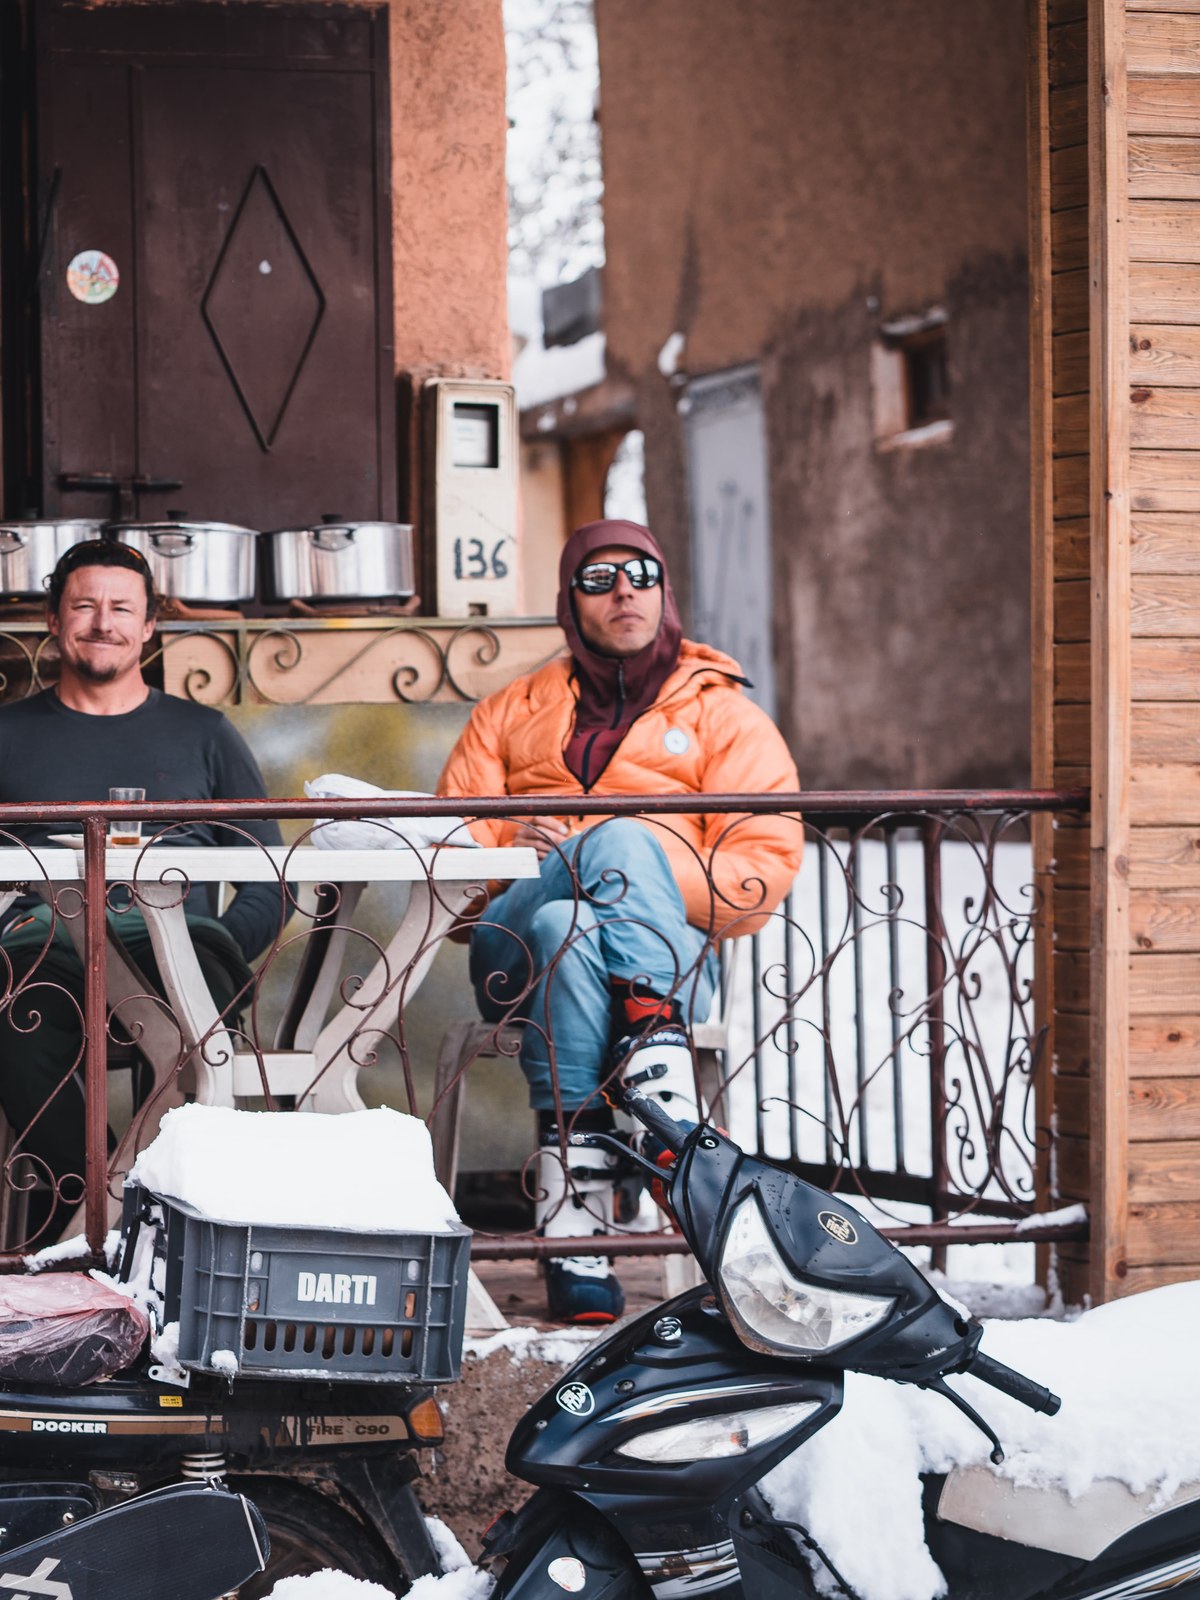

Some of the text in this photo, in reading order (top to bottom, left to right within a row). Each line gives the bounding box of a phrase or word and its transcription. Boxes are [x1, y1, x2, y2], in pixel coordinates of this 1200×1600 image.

[454, 538, 508, 580] 136
[297, 1272, 377, 1305] DARTI
[32, 1420, 107, 1434] DOCKER
[355, 1424, 390, 1435] C90
